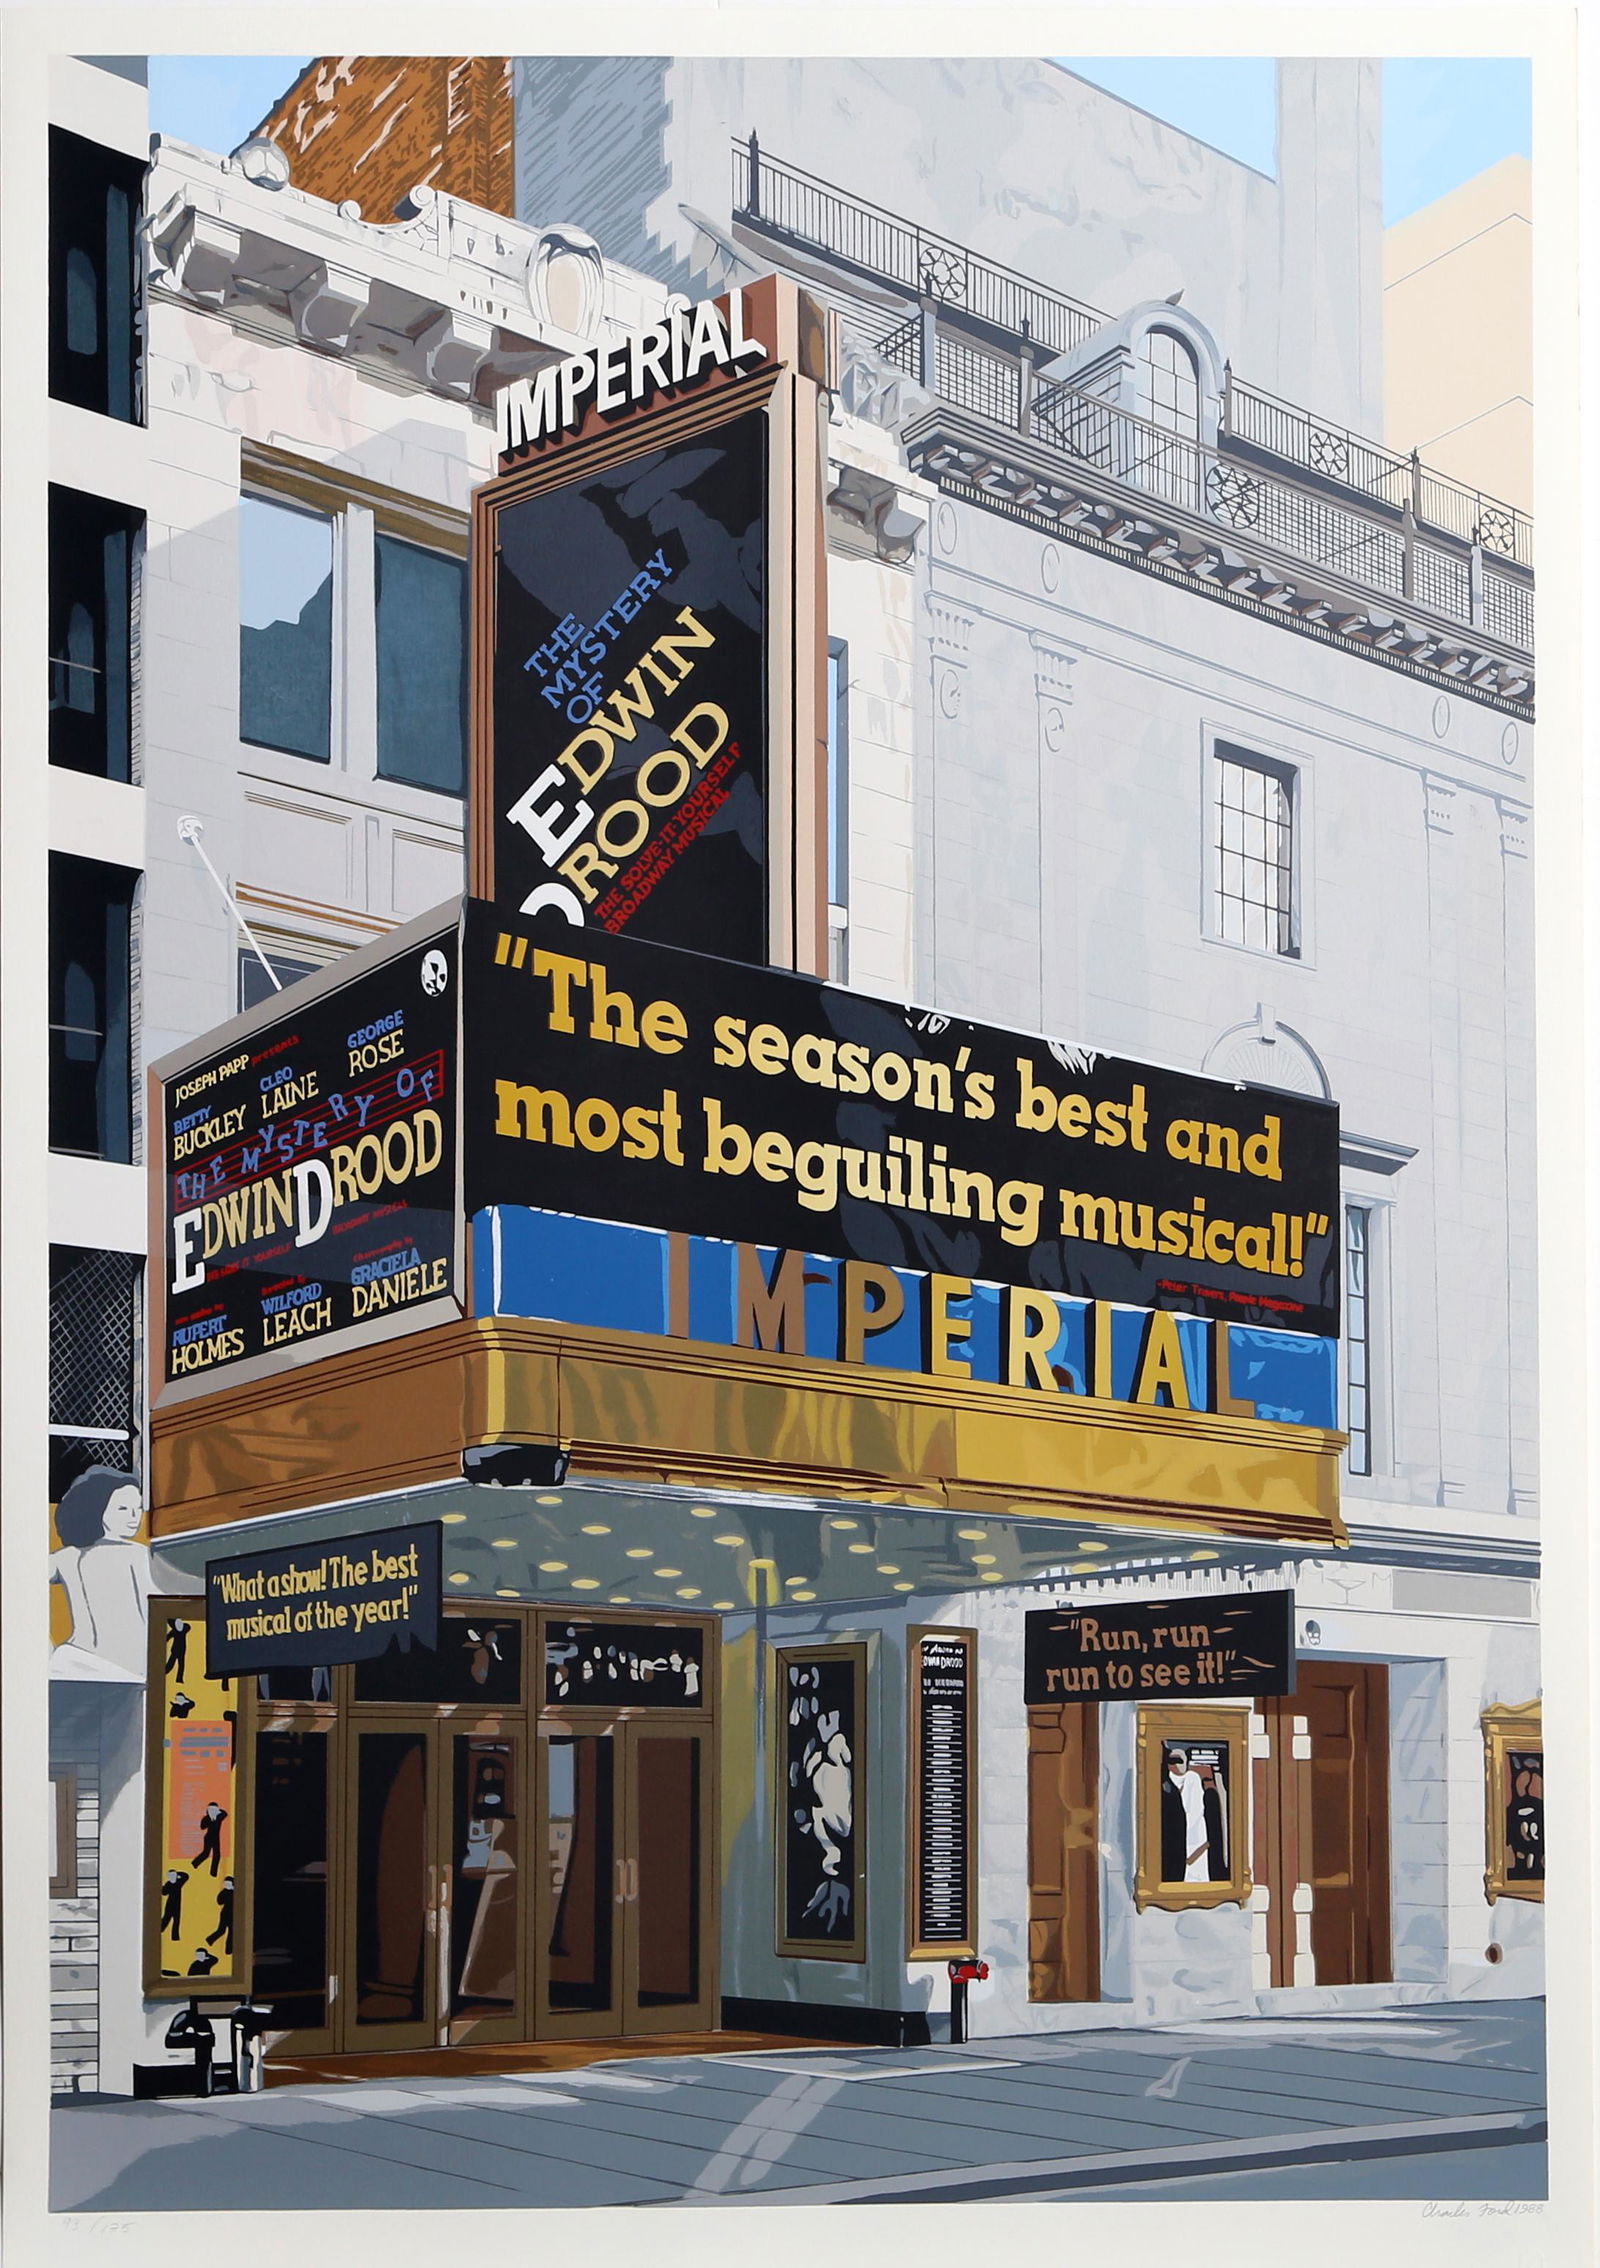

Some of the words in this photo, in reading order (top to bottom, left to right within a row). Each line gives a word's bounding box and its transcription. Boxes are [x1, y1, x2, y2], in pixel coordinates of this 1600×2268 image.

[496, 288, 767, 454] IMPERIAL
[523, 612, 586, 678] THE
[541, 548, 673, 709] MYSTERY
[566, 671, 606, 724] OF
[506, 606, 716, 868] EDWIN
[604, 849, 676, 936] BROADWAY
[672, 788, 732, 855] MUSICAL
[594, 887, 625, 919] THE
[347, 1009, 405, 1049] GEORGE
[348, 1028, 405, 1078] ROSE
[494, 932, 688, 1055] "The
[713, 1015, 996, 1121] season's
[1015, 1057, 1149, 1153] best
[1165, 1115, 1283, 1181] and
[175, 1070, 218, 1109] JOSEPH
[218, 1054, 250, 1082] PAPP
[259, 1065, 293, 1092] CLEO
[260, 1070, 319, 1119] LAINE
[173, 1105, 212, 1136] BETTY
[173, 1104, 247, 1161] BUCKLEY
[176, 1154, 227, 1200] THE
[240, 1093, 375, 1174] MYSTERY
[396, 1067, 435, 1102] OF
[172, 1168, 294, 1295] EDWIN
[293, 1108, 443, 1248] DROOD
[495, 1078, 685, 1167] most
[703, 1096, 1044, 1247] beguiling
[1059, 1188, 1329, 1278] musical!"
[351, 1247, 422, 1286] GRACIELA
[351, 1257, 448, 1318] DANIELE
[260, 1282, 323, 1316] WILFORD
[262, 1296, 332, 1347] LEACH
[666, 1230, 1256, 1419] IMPERIAL
[171, 1328, 245, 1375] HOLMES
[172, 1314, 228, 1347] RUPERT
[212, 1569, 265, 1604] "What
[329, 1554, 368, 1588] The
[371, 1543, 419, 1583] best
[226, 1606, 291, 1641] musical
[294, 1602, 314, 1633] of
[314, 1601, 348, 1630] the
[351, 1584, 418, 1633] year!"
[1152, 1623, 1211, 1649] run
[1045, 1662, 1100, 1693] run
[1107, 1660, 1134, 1689] to
[1140, 1661, 1191, 1688] see
